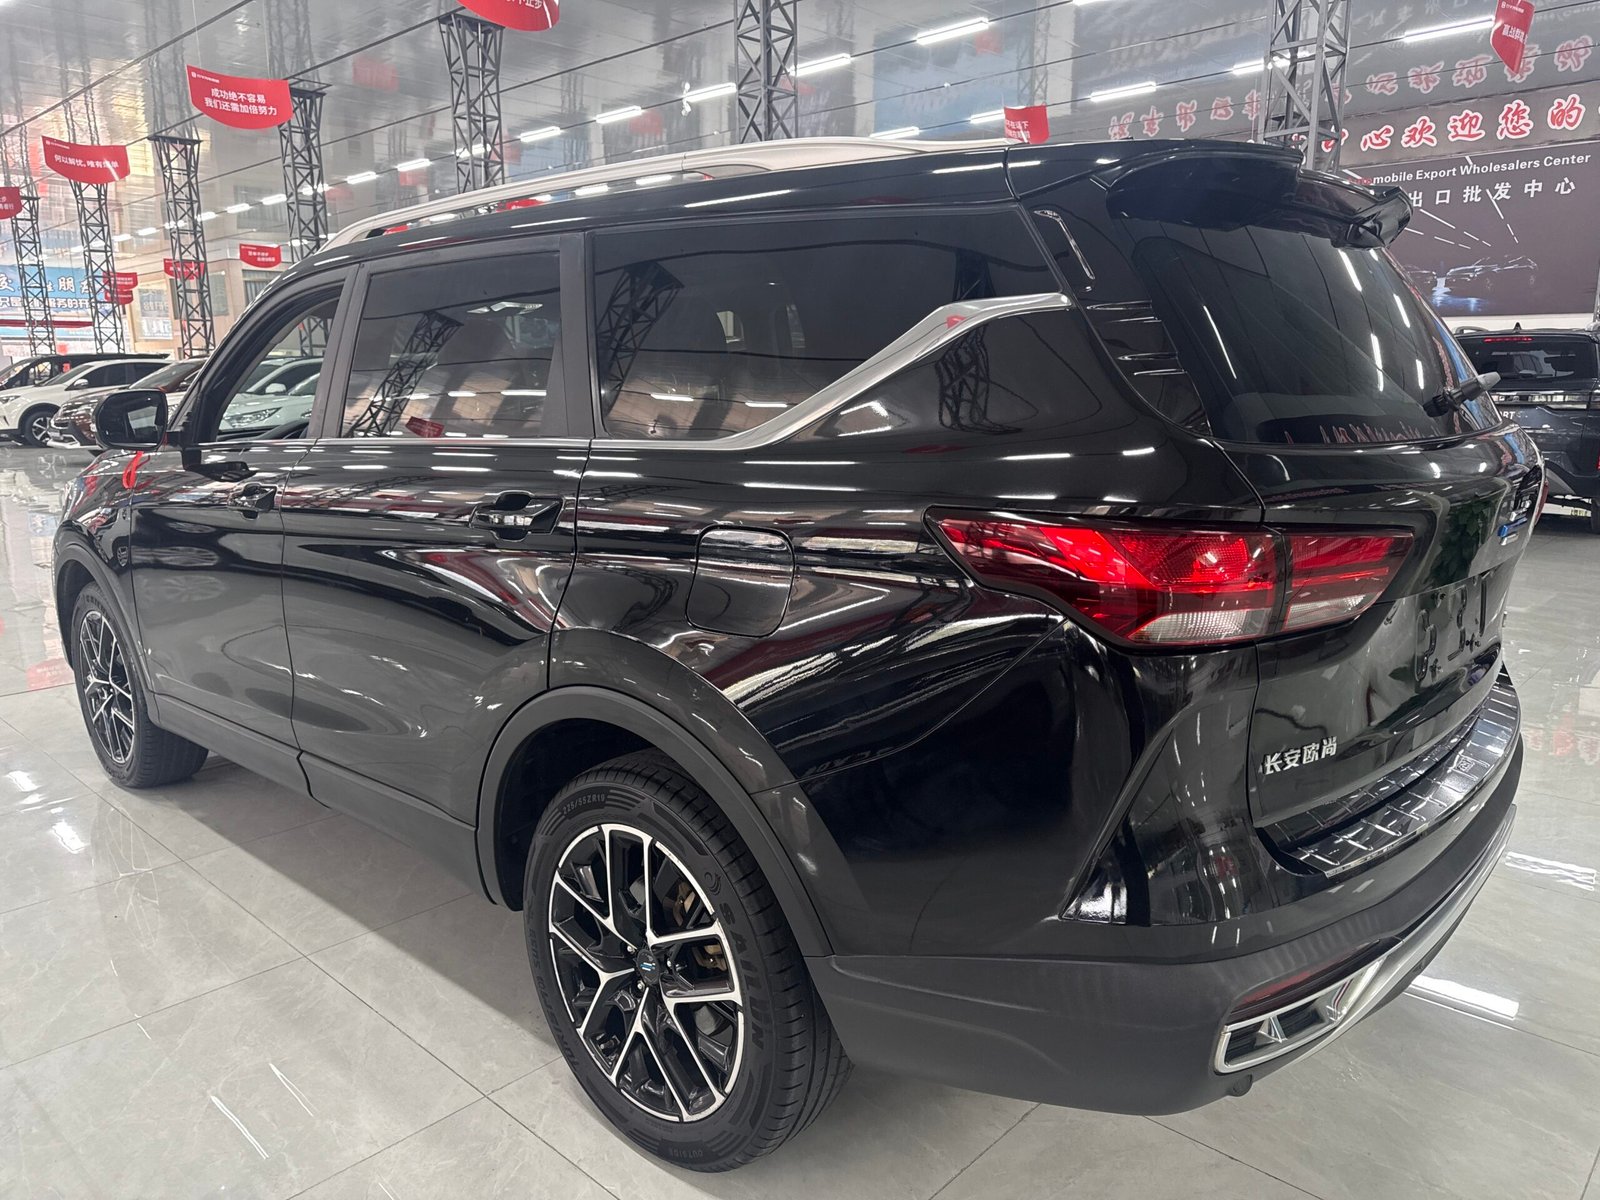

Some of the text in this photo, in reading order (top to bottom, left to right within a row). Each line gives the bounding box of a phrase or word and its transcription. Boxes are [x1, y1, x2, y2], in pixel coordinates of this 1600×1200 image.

[204, 97, 277, 115] 我们还需加倍努力
[211, 87, 266, 104] 成功绝不容易
[1416, 167, 1457, 182] Export
[1459, 159, 1540, 176] Wholesalers
[1543, 154, 1591, 167] Center
[1408, 177, 1576, 208] 出口批发中心
[1264, 736, 1337, 775] 长安欧尚
